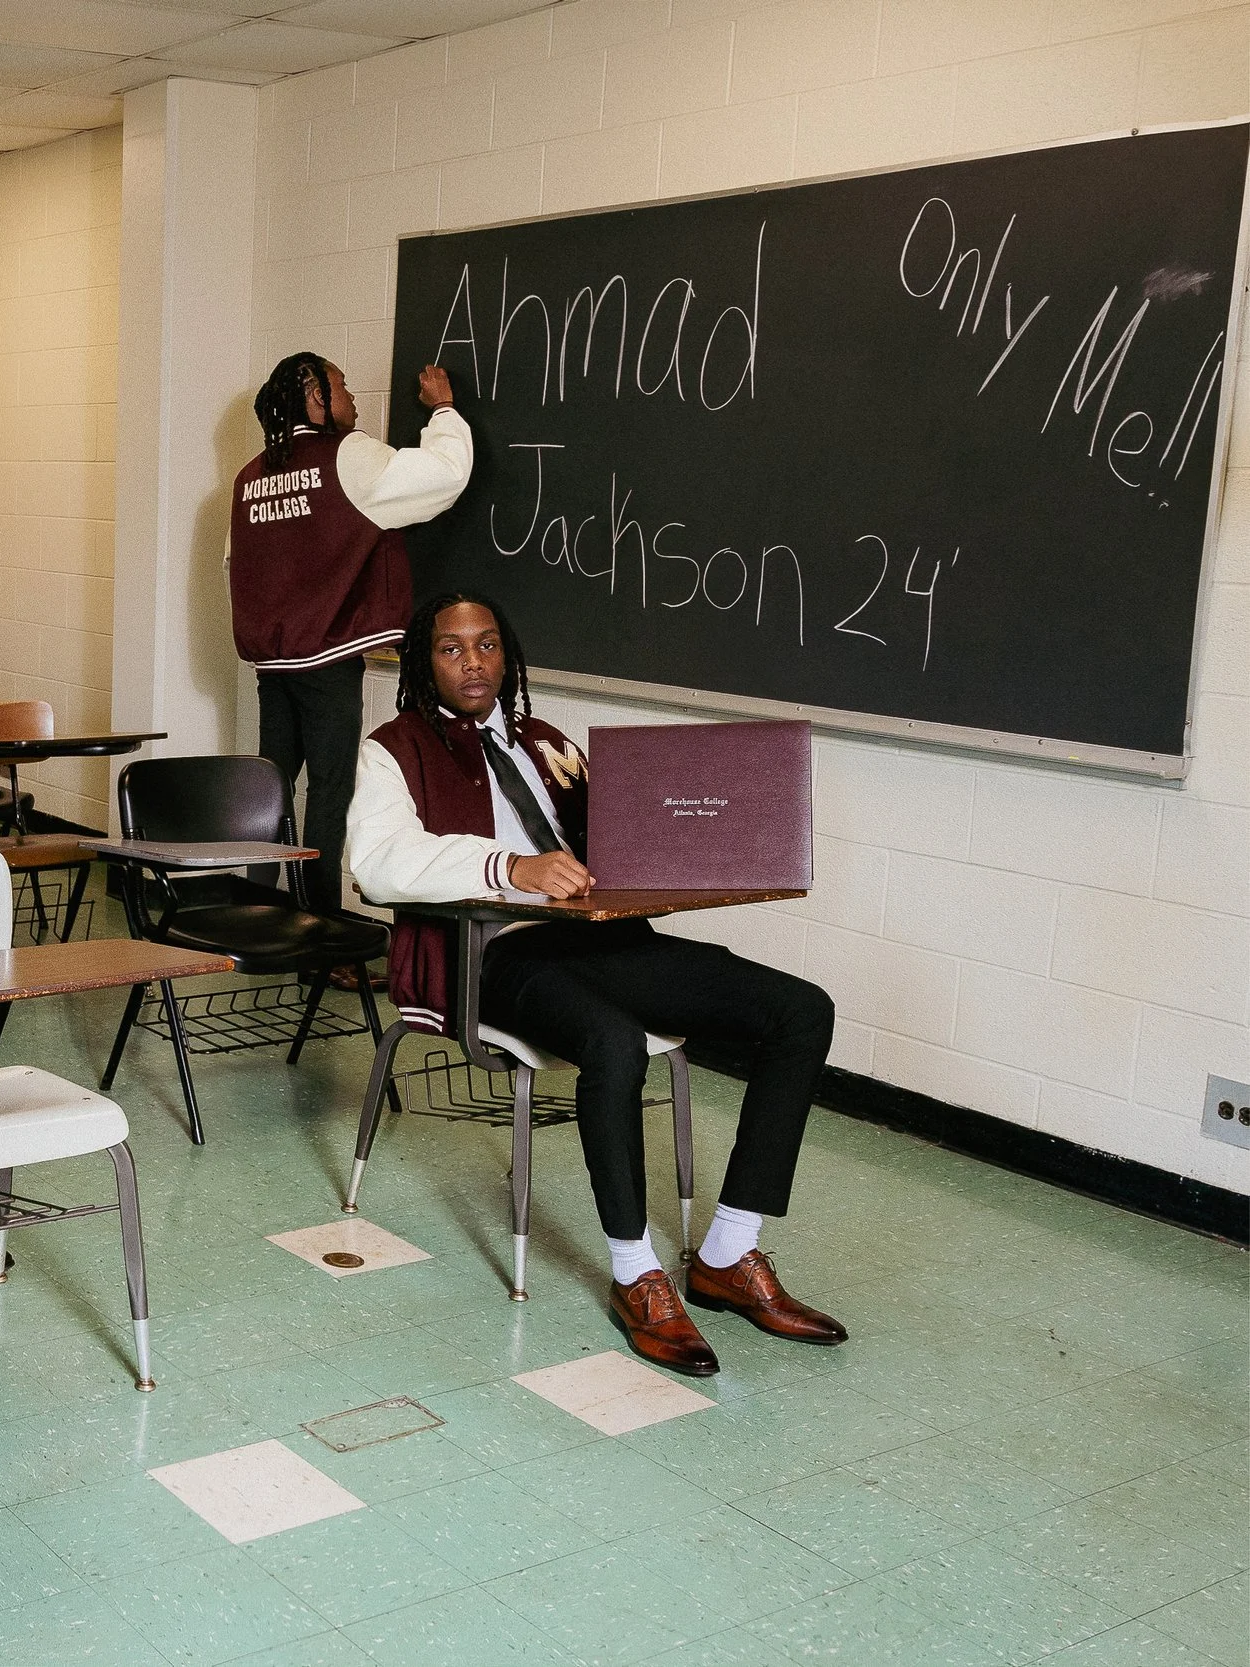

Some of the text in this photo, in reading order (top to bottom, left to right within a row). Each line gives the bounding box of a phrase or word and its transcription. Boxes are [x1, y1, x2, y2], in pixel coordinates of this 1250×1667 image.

[434, 219, 767, 411] Ahmad
[900, 197, 1050, 397] Only
[242, 467, 322, 502] MOREHOUSE
[249, 495, 311, 524] COLLEGE
[491, 444, 804, 647] Jackson
[534, 739, 588, 789] M
[662, 797, 729, 808] Morehouse College
[696, 809, 719, 817] Georgia
